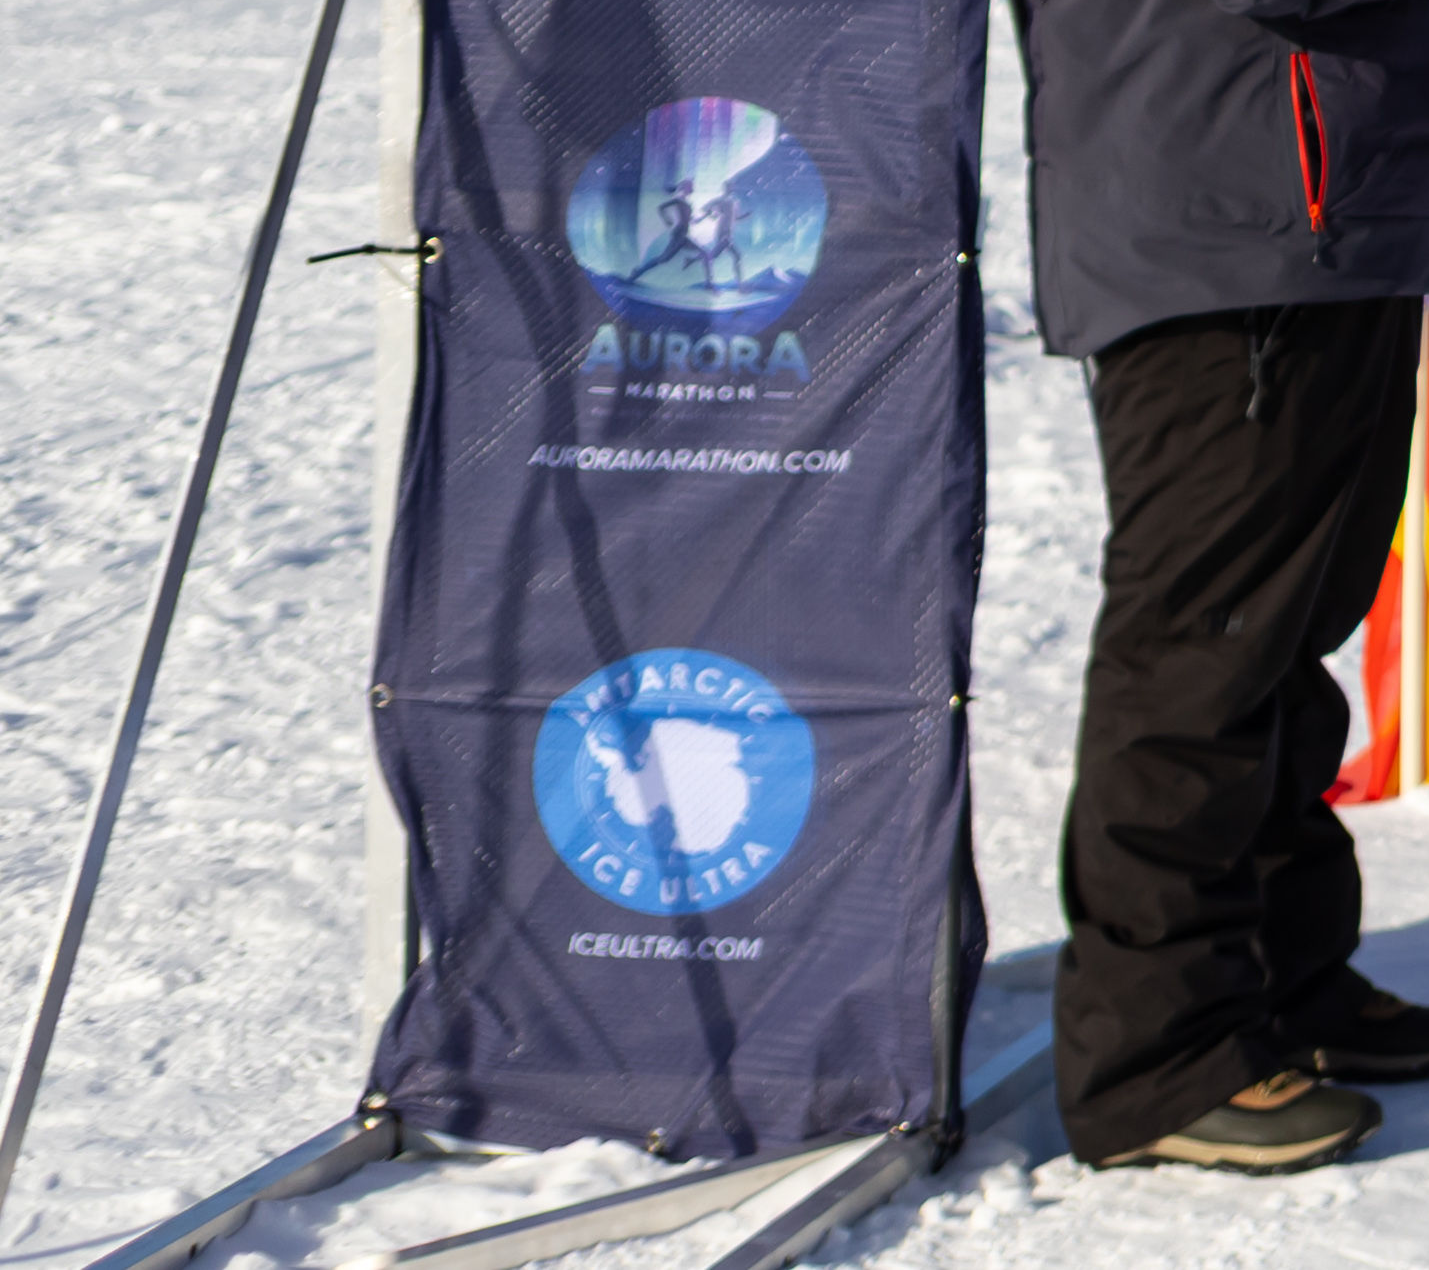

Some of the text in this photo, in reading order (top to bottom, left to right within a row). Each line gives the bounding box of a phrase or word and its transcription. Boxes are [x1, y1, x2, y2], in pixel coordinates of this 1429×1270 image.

[581, 323, 812, 383] AURORA
[625, 382, 757, 402] MARATHON
[527, 444, 853, 474] AURORAMARATHON.COM
[579, 841, 772, 905] ICE ULTRA
[568, 932, 764, 960] ICEULTRA.COM
